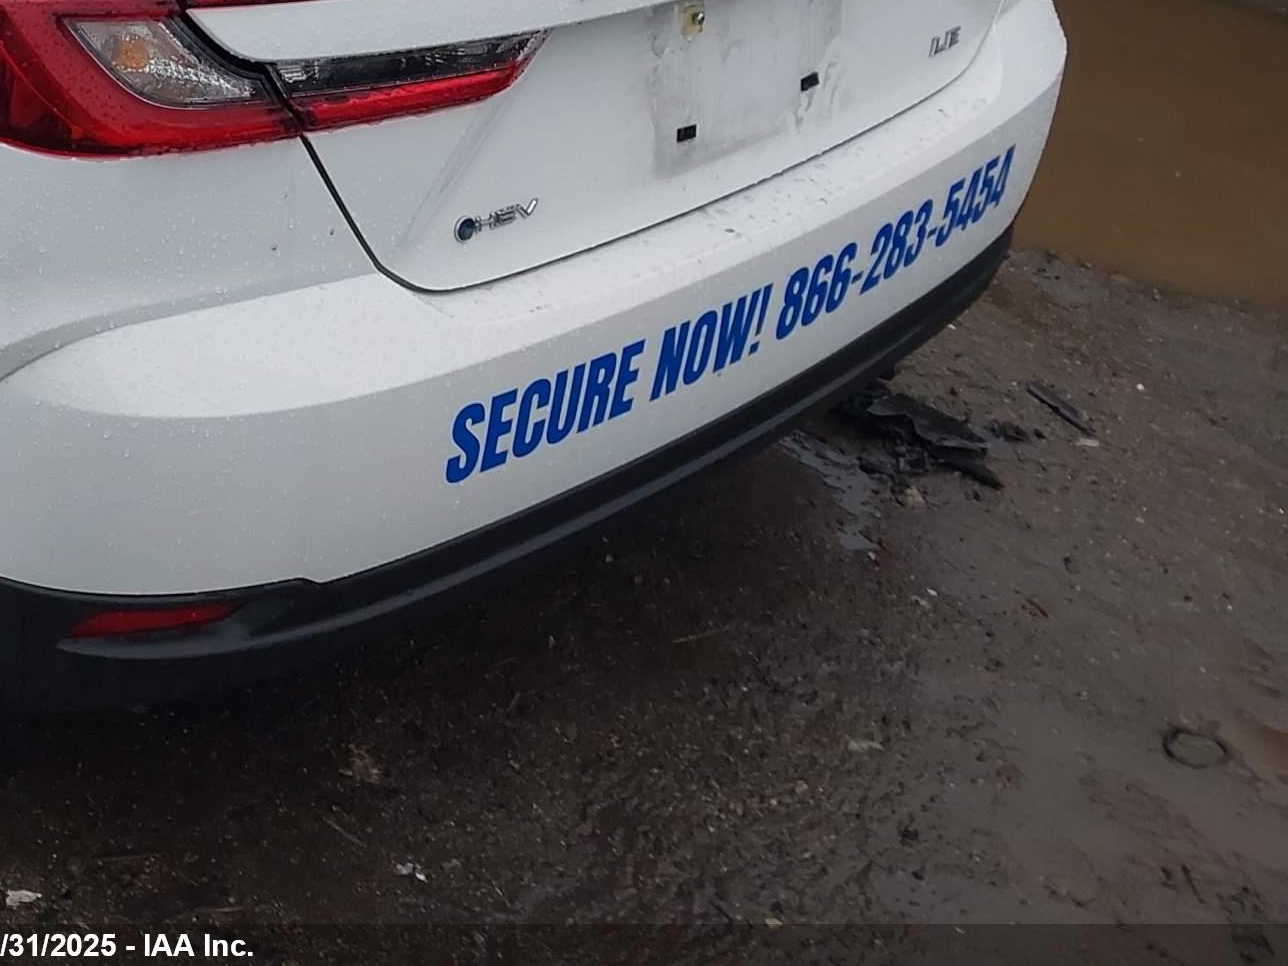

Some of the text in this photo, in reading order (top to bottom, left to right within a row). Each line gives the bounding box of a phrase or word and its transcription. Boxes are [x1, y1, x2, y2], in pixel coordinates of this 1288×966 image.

[474, 196, 539, 235] HEV
[444, 142, 1017, 485] SECURE NOW! 866-283-5454
